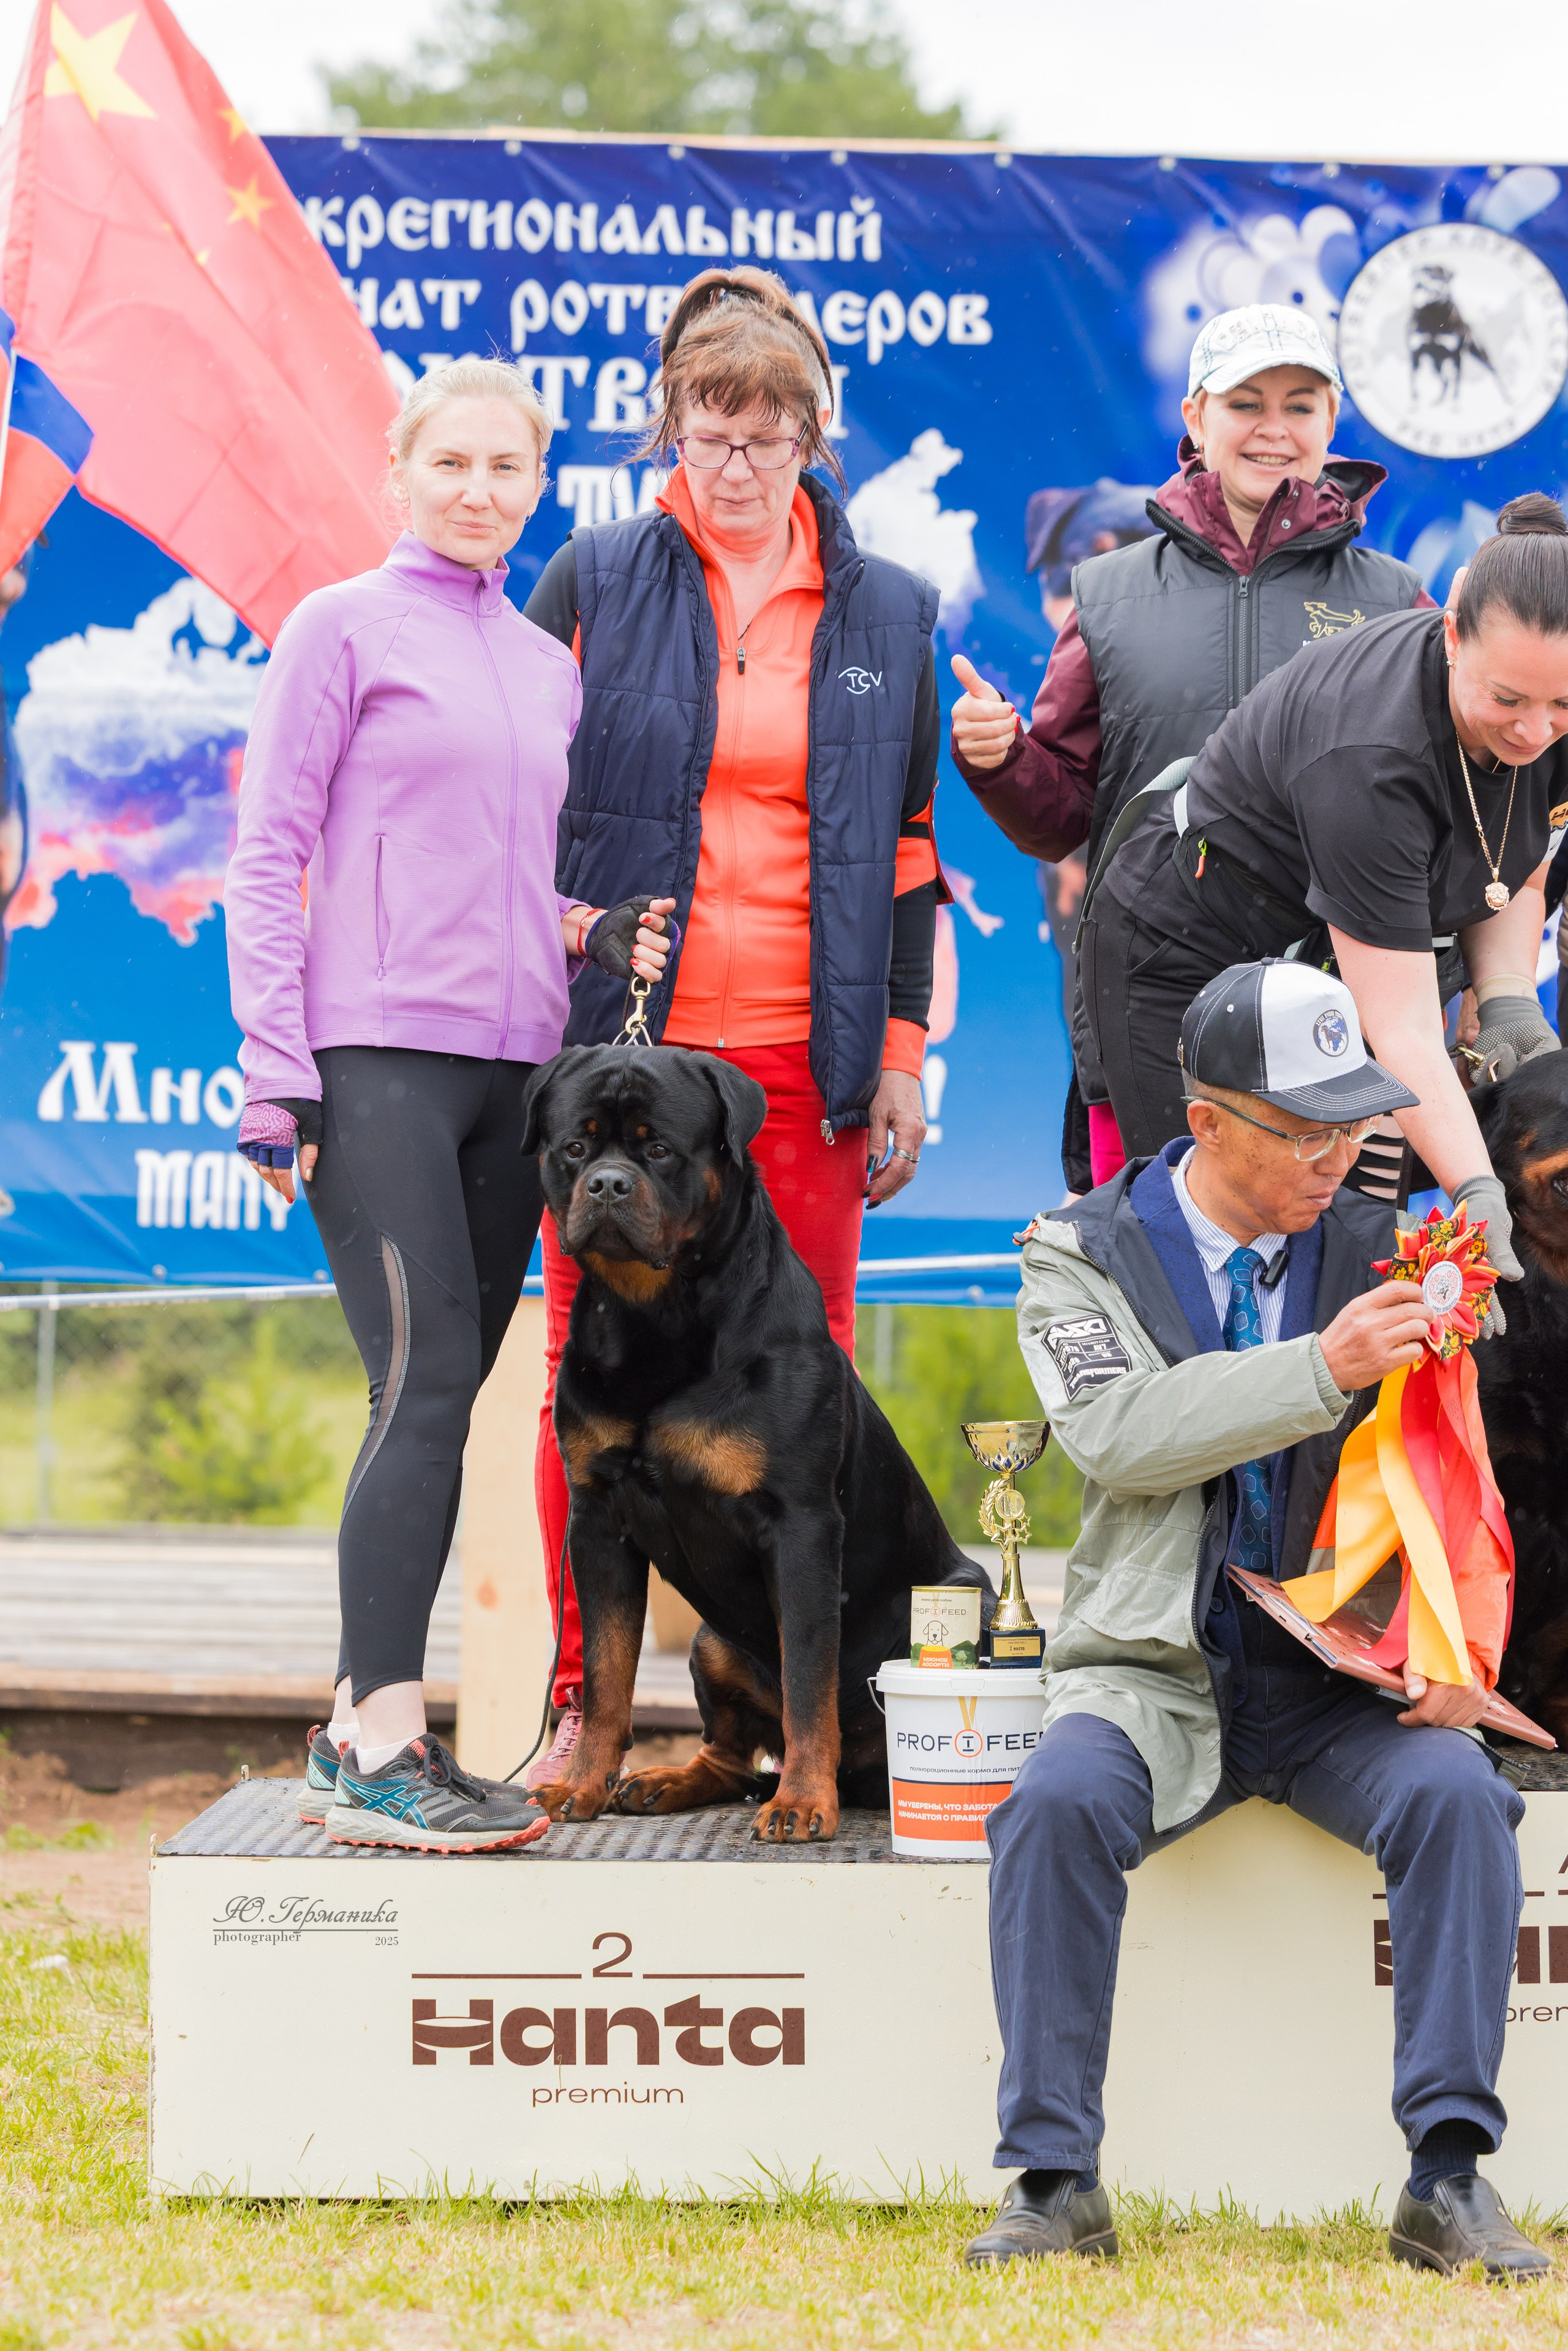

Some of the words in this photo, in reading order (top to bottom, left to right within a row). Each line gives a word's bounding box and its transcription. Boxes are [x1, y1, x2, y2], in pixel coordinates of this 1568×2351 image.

[844, 669, 883, 690] TCV
[898, 1810, 942, 1821] НАЧИНАЕТСЯ
[907, 1800, 943, 1811] УВЕРЕНЫ,
[592, 1931, 633, 1978] 2
[412, 1993, 805, 2066] Hanta
[532, 2081, 684, 2108] premium
